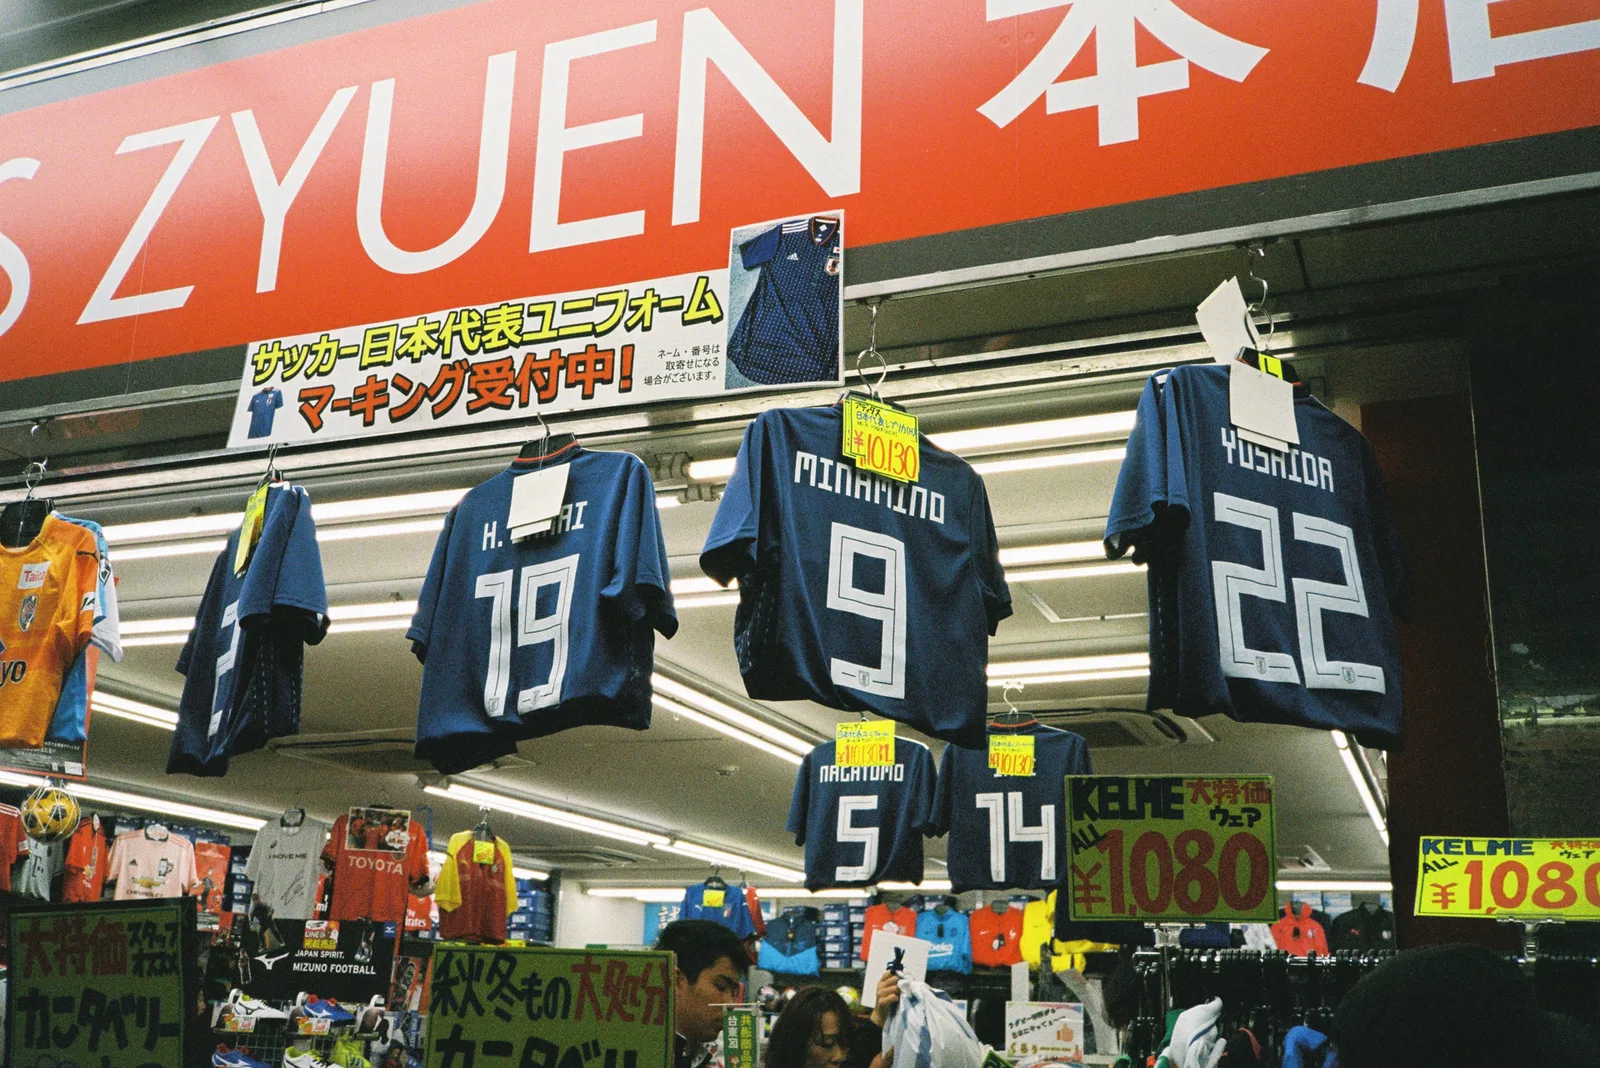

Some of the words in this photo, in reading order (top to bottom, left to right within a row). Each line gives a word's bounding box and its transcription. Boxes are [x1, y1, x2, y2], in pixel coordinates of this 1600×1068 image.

[76, 0, 862, 325] ZYUEN
[252, 275, 724, 385] サッカー日本代表ユニフォーム
[644, 370, 717, 386] 場合がございます。
[665, 357, 720, 371] 取寄せになる
[1221, 427, 1334, 493] YOSHIDA
[795, 451, 945, 525] MINAMINO
[482, 521, 503, 551] H.
[826, 521, 907, 700] 9
[1211, 492, 1386, 695] 22
[475, 554, 580, 718] 19
[820, 764, 904, 783] NAGATOMO
[1186, 777, 1270, 805] 大特価
[1072, 777, 1184, 822] KELME
[1209, 805, 1262, 828] ウェア
[835, 795, 879, 881] 5
[976, 791, 1056, 882] 14
[1071, 824, 1107, 855] ALL
[1422, 838, 1535, 856] KELME
[348, 855, 403, 876] TOYOTA
[1422, 857, 1459, 874] ALL
[19, 915, 128, 978] 大特価
[295, 949, 318, 958] JAPAN
[320, 950, 345, 959] SPIRIT.
[292, 962, 328, 973] MIZUNO
[330, 963, 376, 975] FOOTBALL
[17, 986, 180, 1051] カンタベリー
